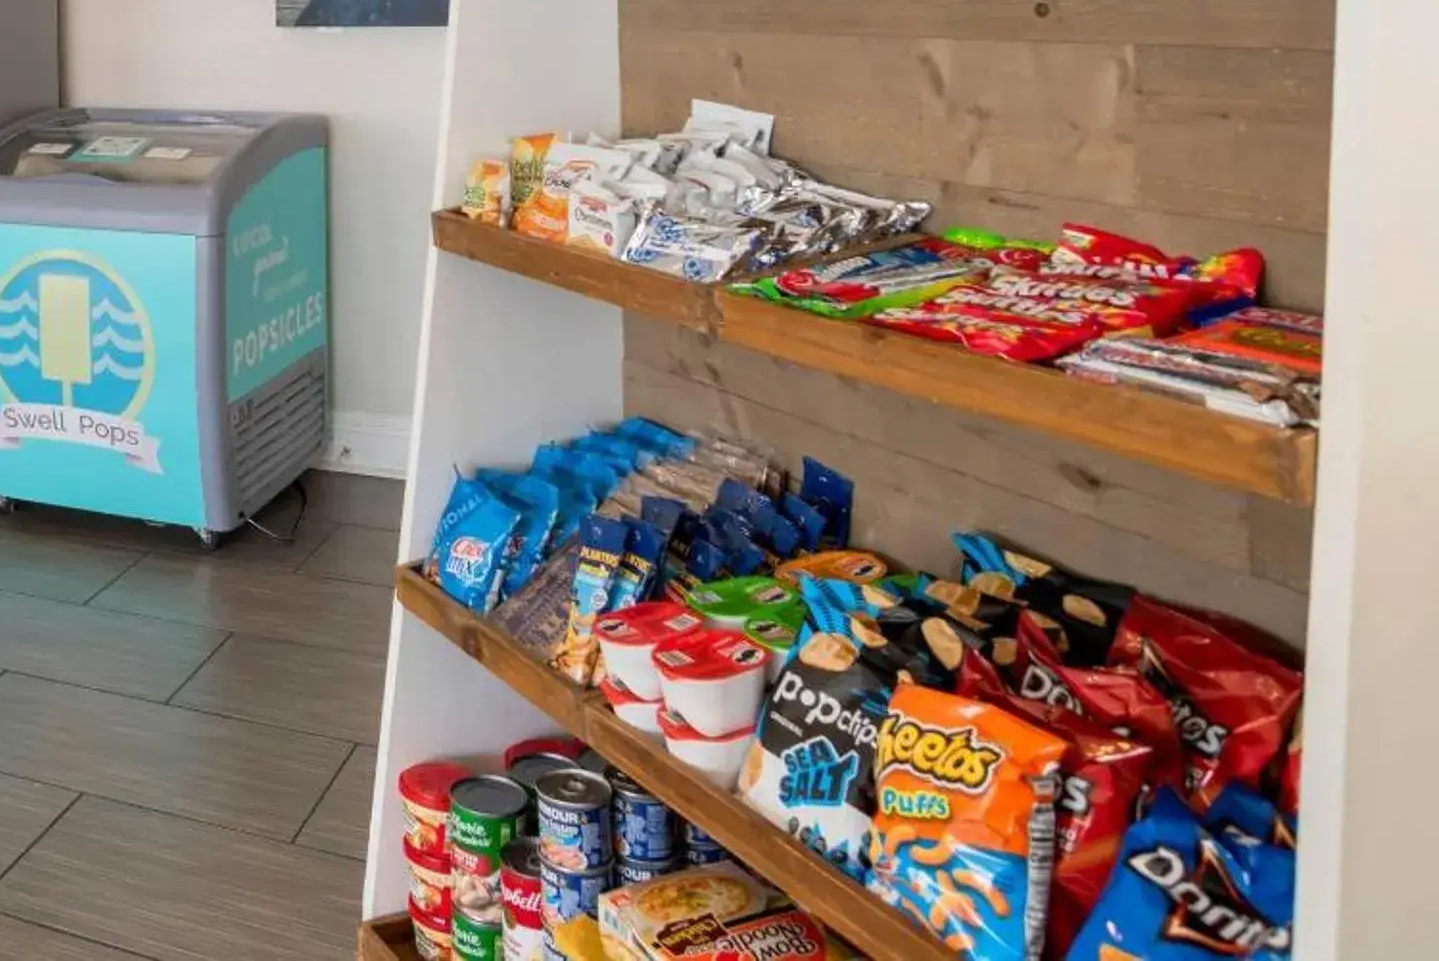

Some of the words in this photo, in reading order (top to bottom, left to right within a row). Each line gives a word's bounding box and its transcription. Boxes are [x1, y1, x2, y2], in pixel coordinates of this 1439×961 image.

[234, 291, 323, 376] POPSICLES
[3, 406, 67, 433] Swell
[79, 414, 139, 446] Pops
[783, 738, 837, 774] SEA
[877, 715, 1002, 787] heetos
[778, 752, 858, 805] SALT
[882, 788, 950, 817] Puffs
[717, 922, 805, 952] Noodle
